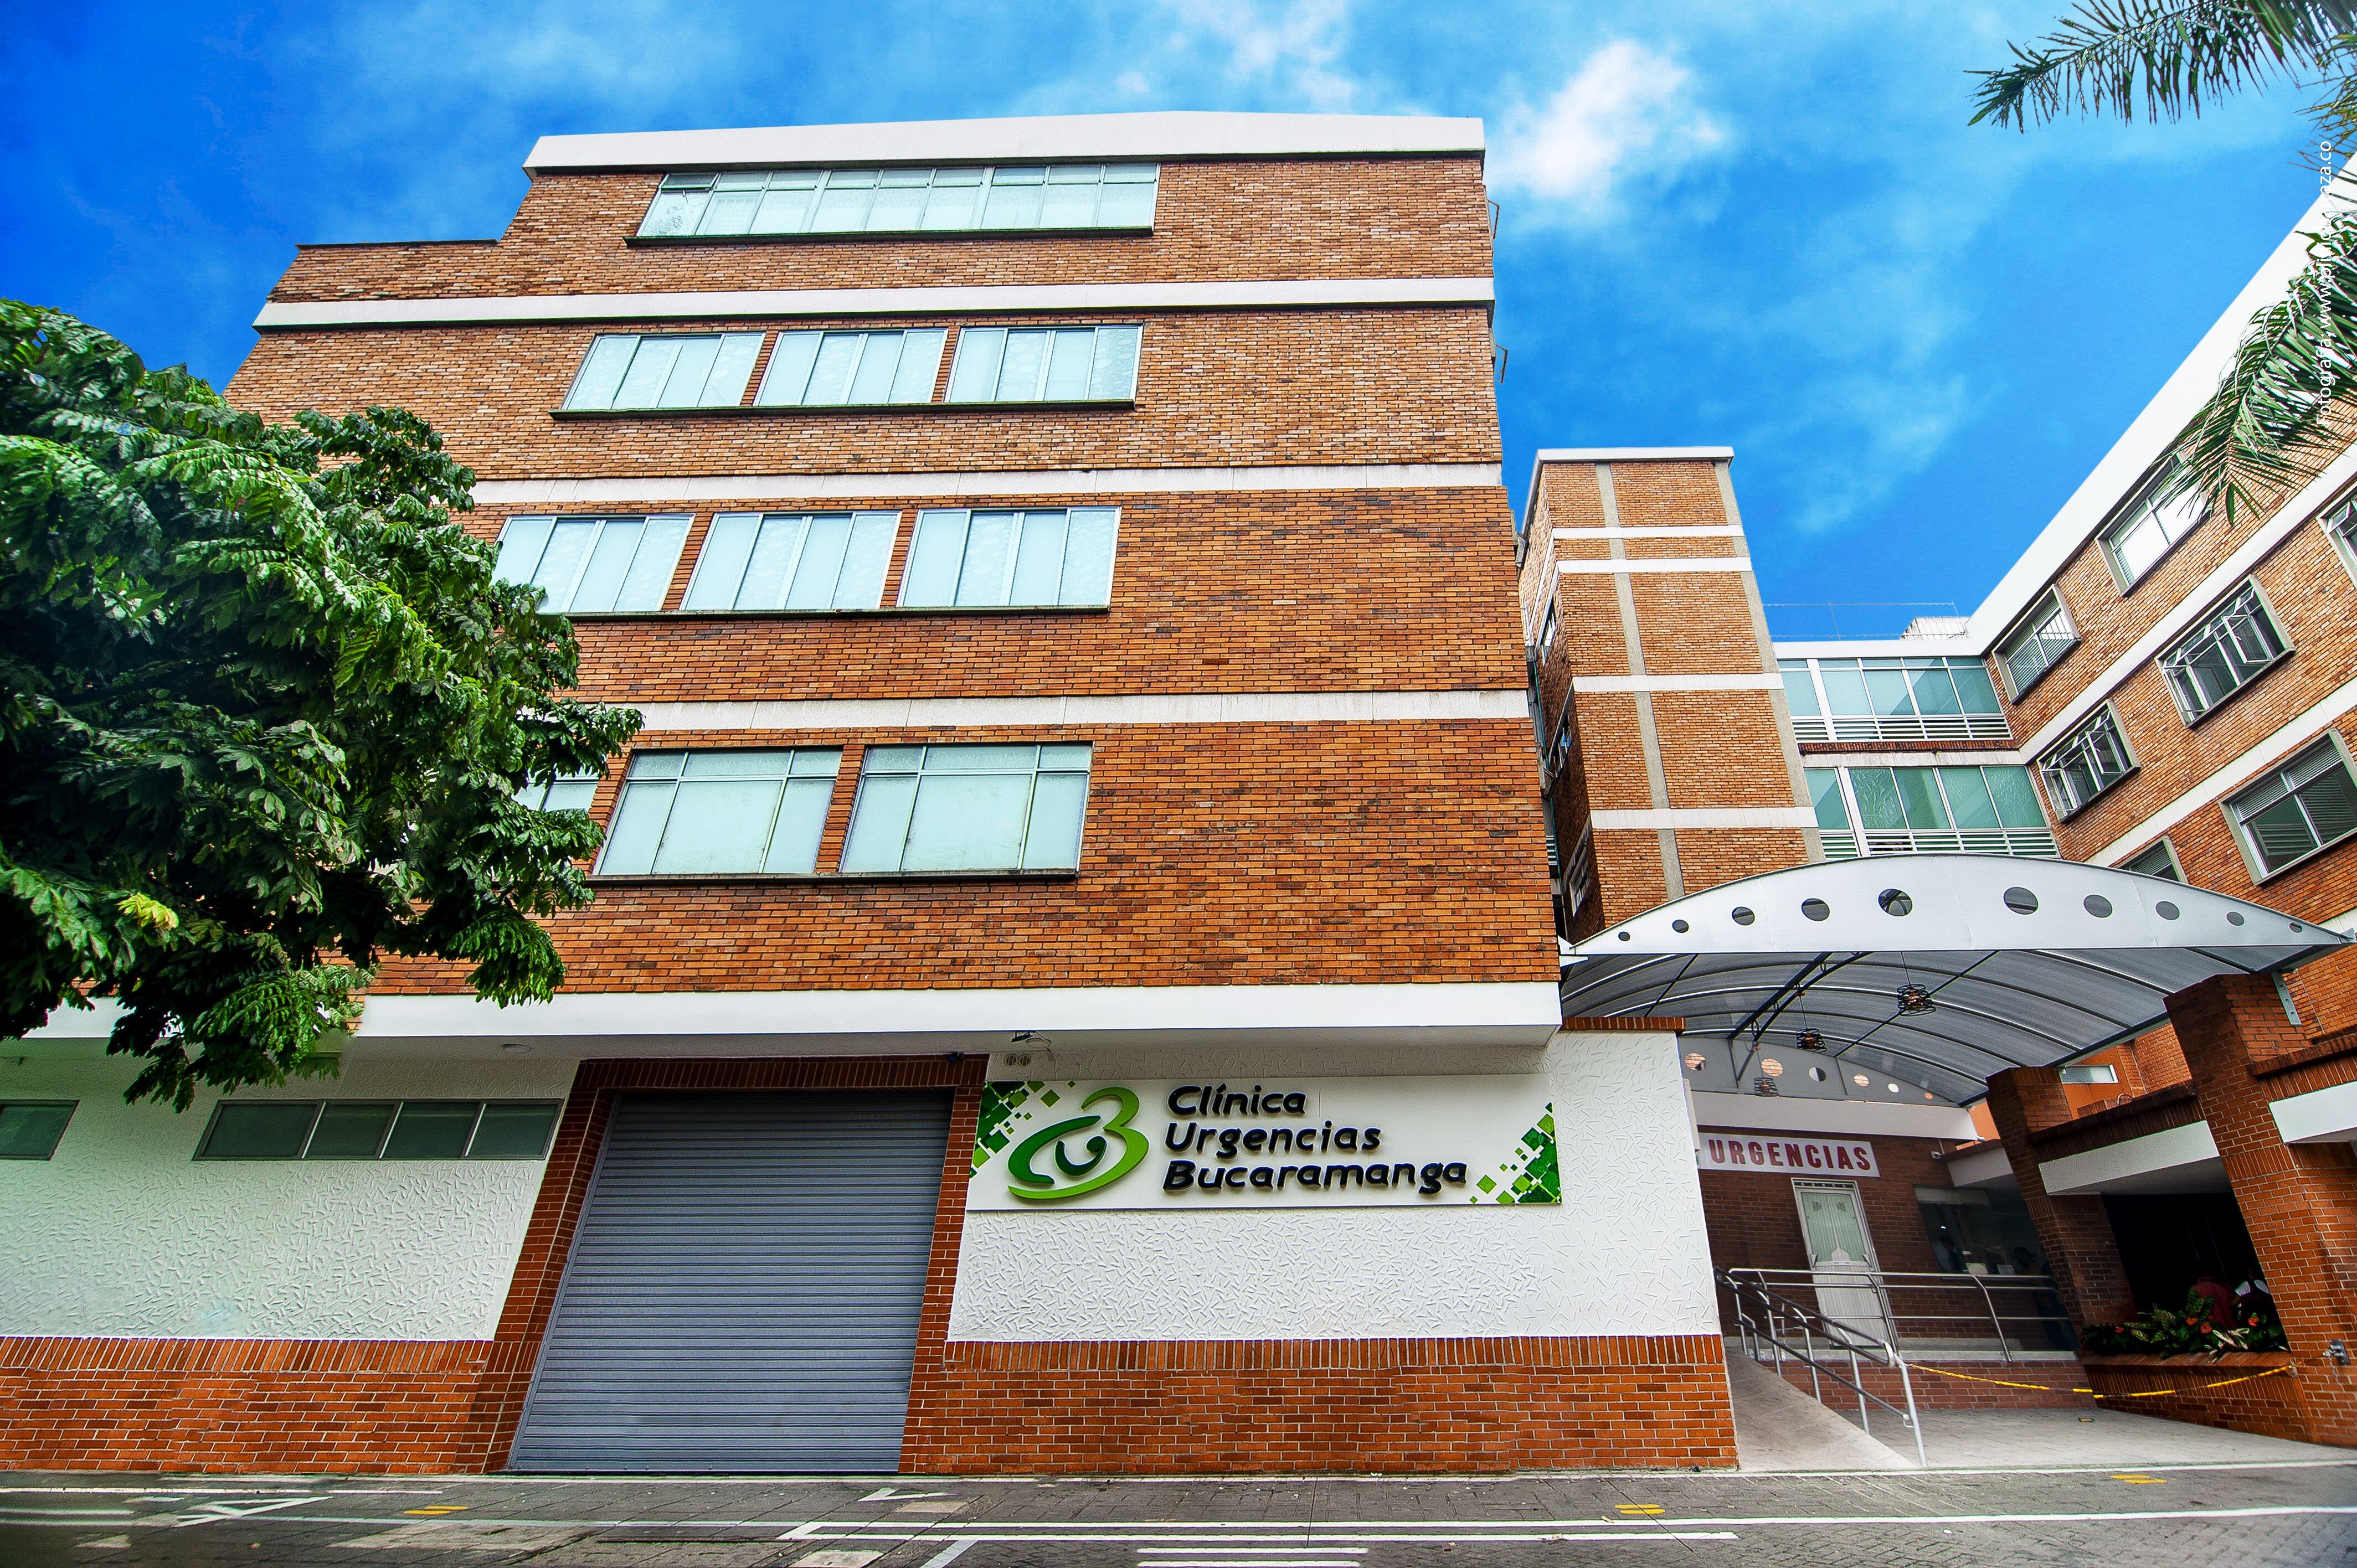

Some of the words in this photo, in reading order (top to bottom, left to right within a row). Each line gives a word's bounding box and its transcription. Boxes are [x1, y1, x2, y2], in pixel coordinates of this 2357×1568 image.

[1167, 1082, 1306, 1115] Clínica
[1164, 1120, 1382, 1159] Urgencias
[1708, 1138, 1871, 1171] URGENCIAS
[1162, 1159, 1469, 1195] Bucaramanga
